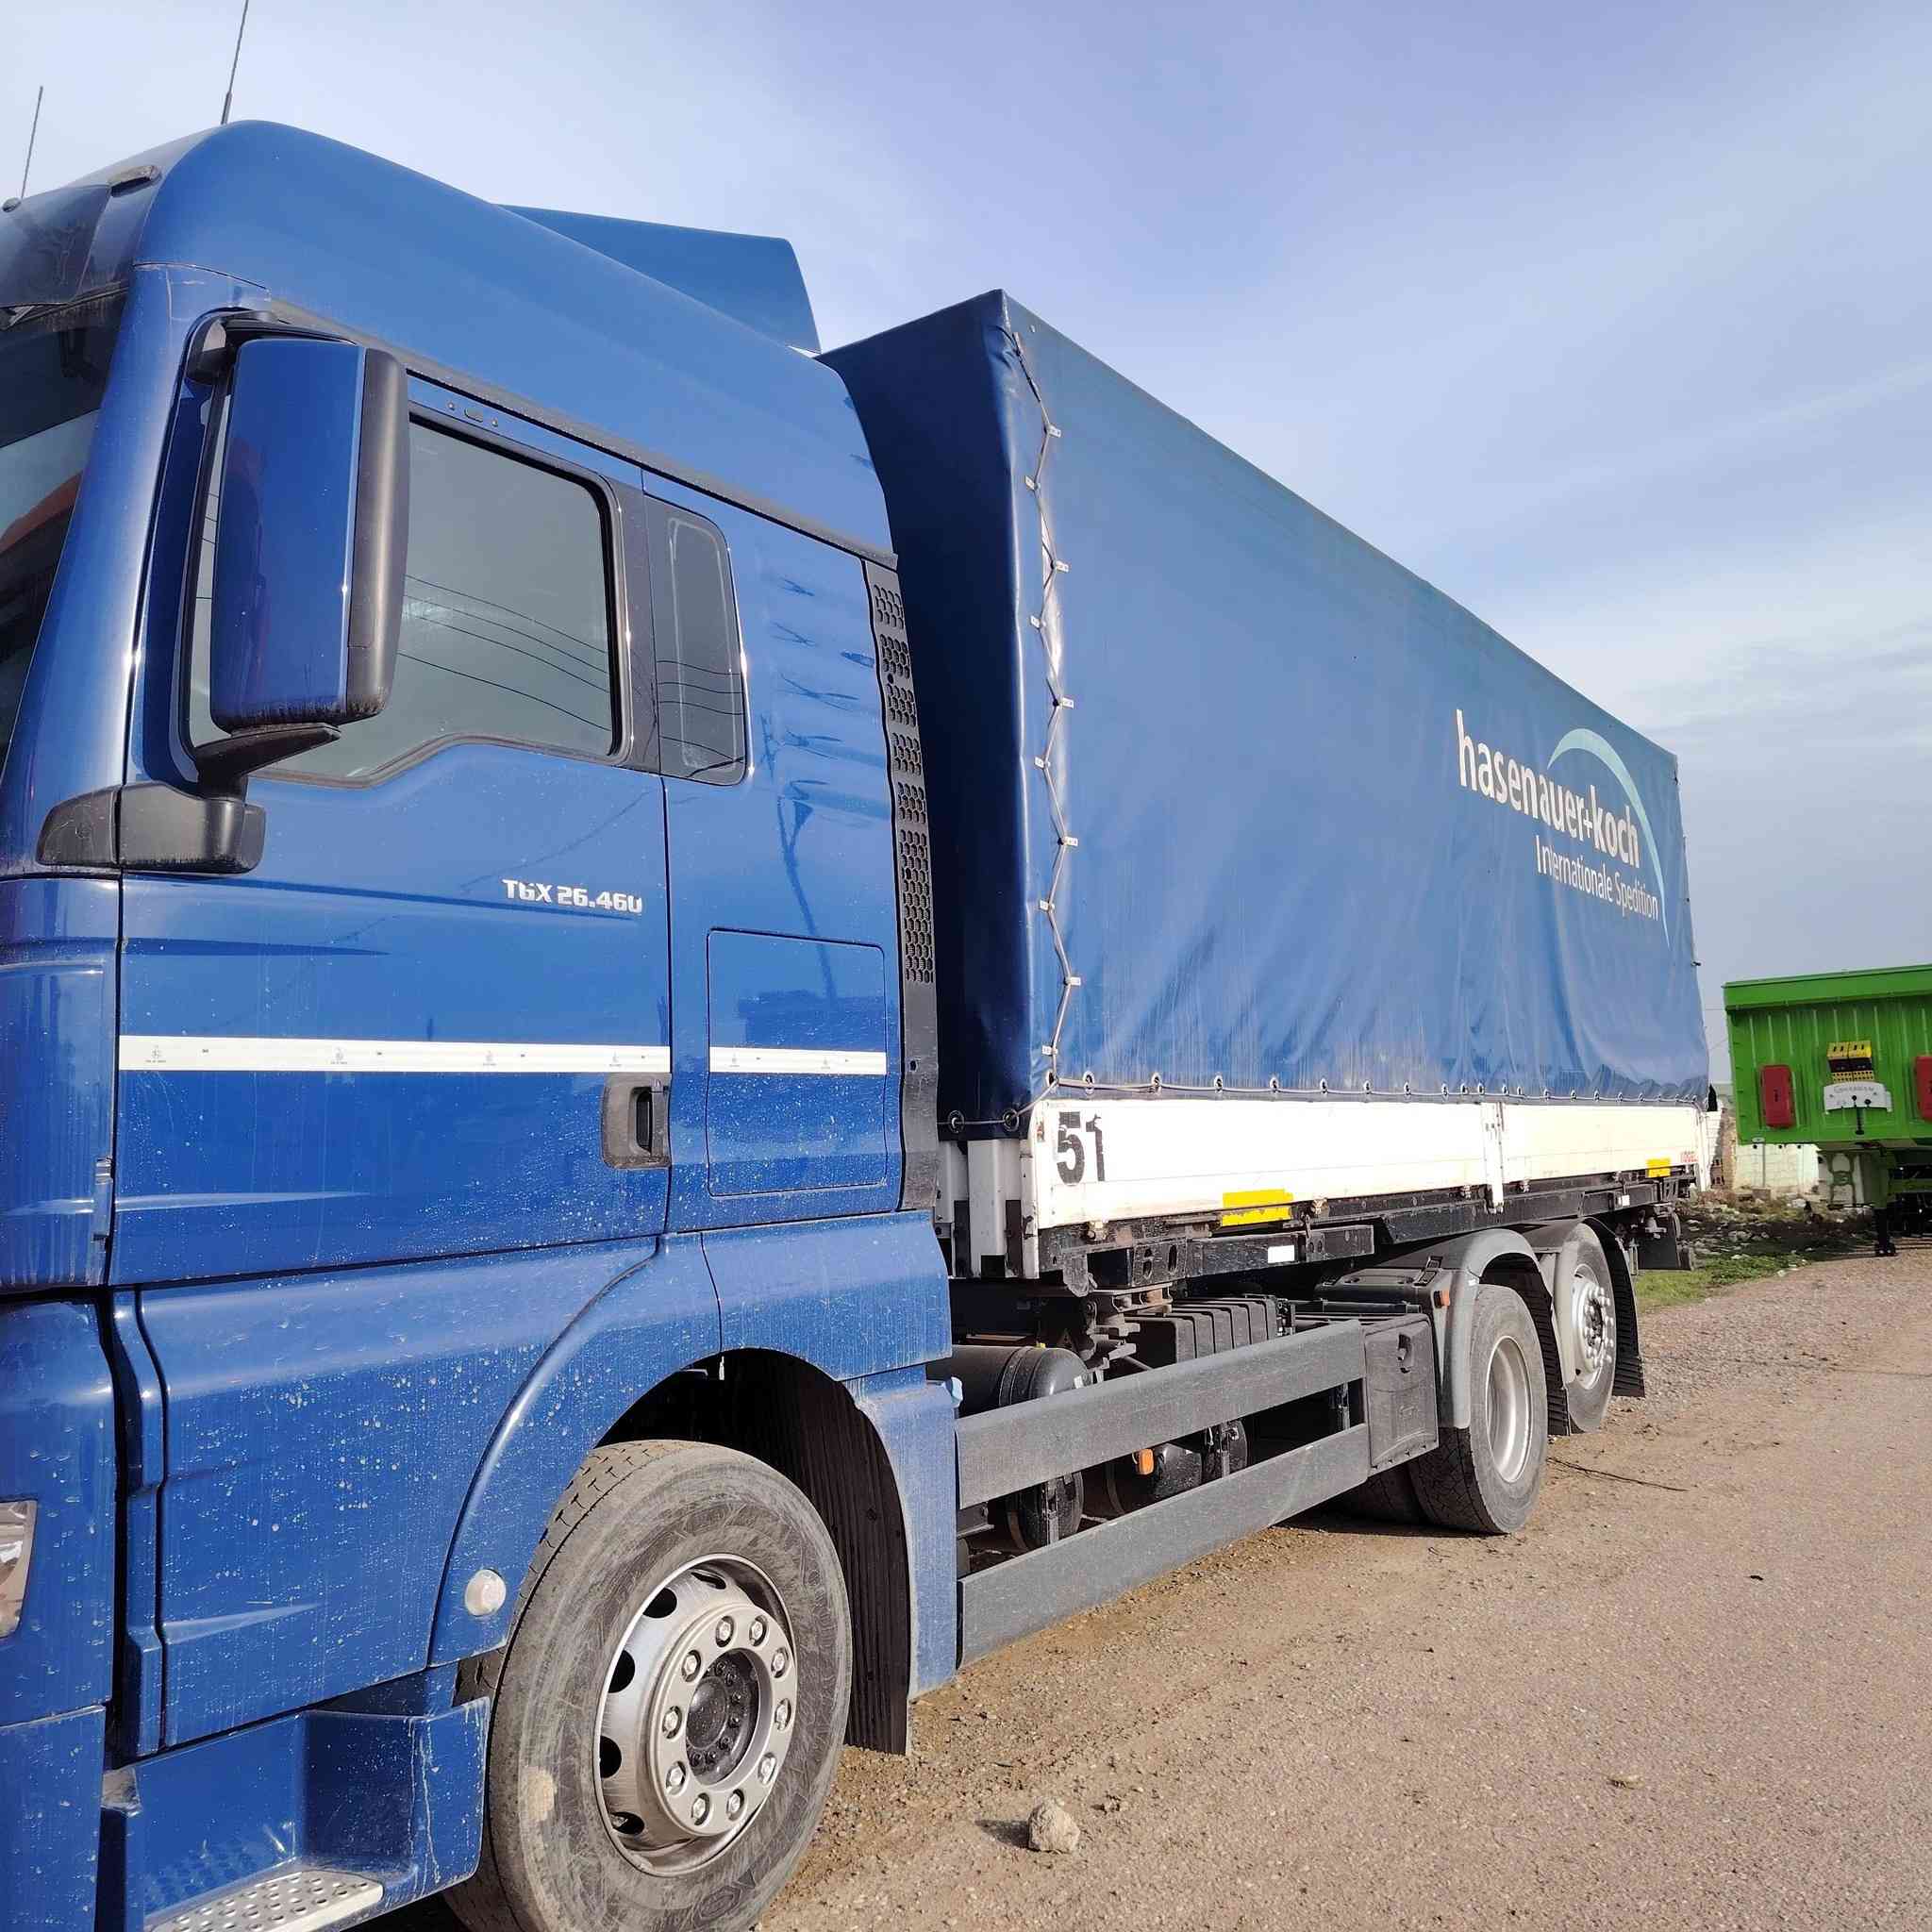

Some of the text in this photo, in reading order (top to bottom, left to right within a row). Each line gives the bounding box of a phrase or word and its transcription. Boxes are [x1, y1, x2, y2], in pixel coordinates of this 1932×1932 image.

[502, 878, 553, 903] TGX
[1535, 834, 1659, 922] Internationale Spedition
[1057, 1111, 1106, 1187] 51
